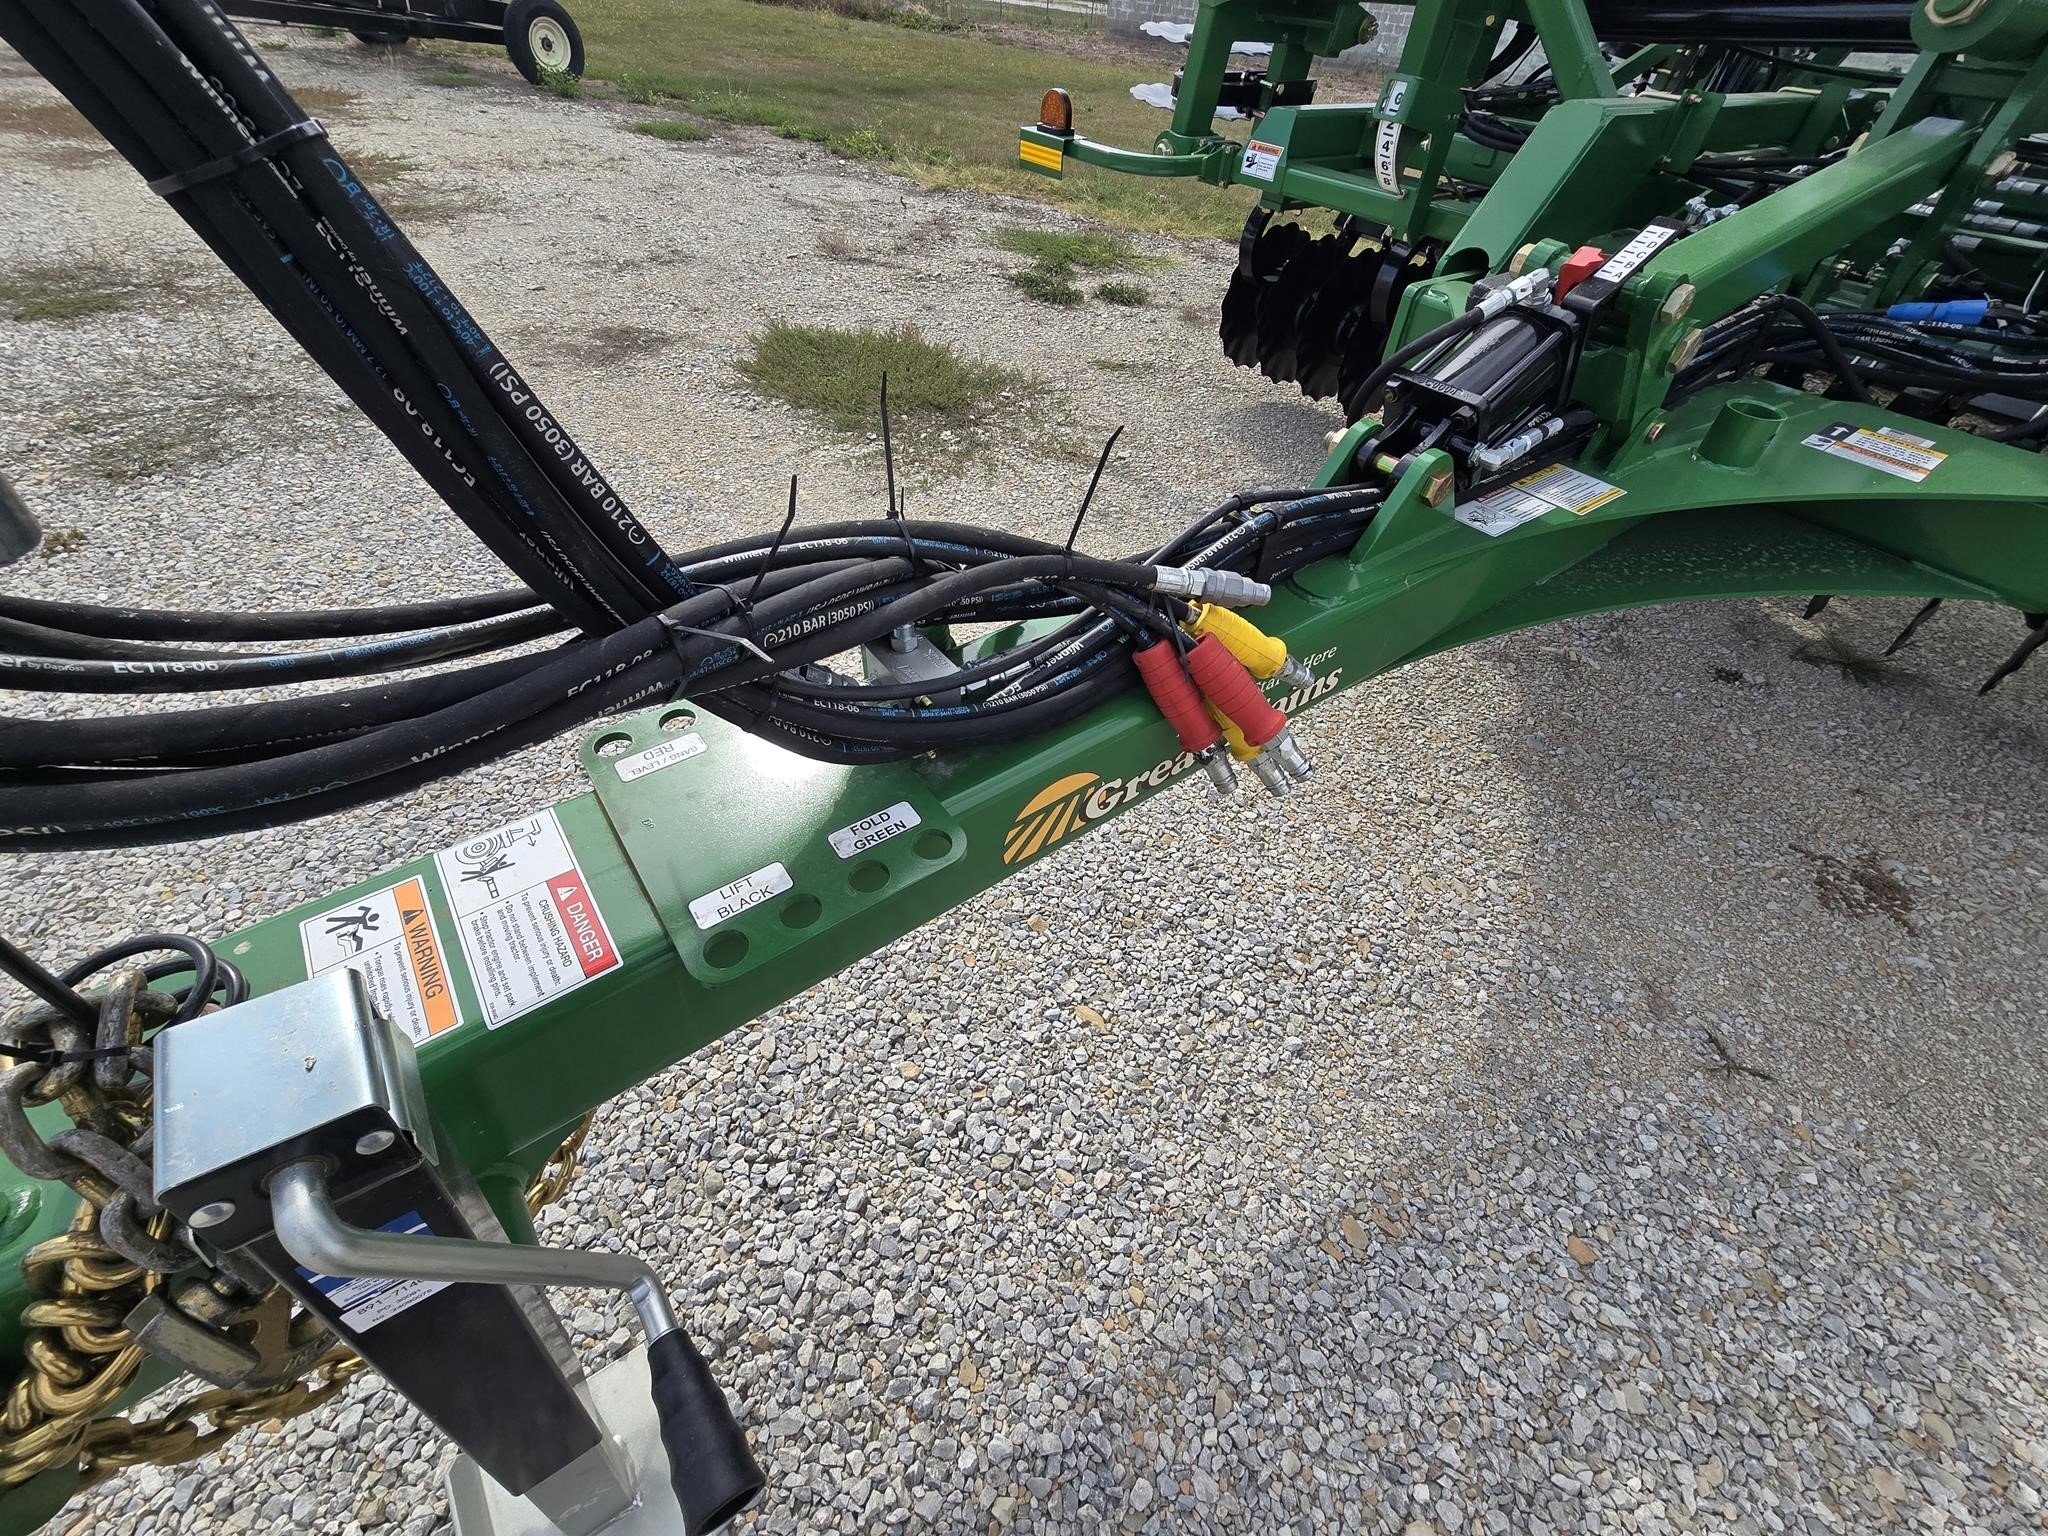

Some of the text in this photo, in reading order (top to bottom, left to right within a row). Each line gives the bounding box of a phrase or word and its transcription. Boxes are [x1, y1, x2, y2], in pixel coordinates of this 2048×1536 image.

[1646, 241, 1658, 249] D
[486, 359, 530, 406] PSI)
[522, 402, 577, 462] (3050
[568, 457, 607, 499] BAR
[600, 495, 634, 530] 210
[775, 597, 876, 643] 210 BAR (3050 PSI)
[27, 660, 219, 674] by Danfoss EC118-06
[1043, 639, 1084, 668] Winner
[1303, 645, 1337, 670] Here
[813, 698, 859, 713] EC118-06
[1266, 666, 1343, 718] ains
[642, 743, 674, 761] RED
[668, 745, 697, 761] GANG
[630, 759, 660, 776] LEVEL
[1082, 751, 1203, 821] Grea
[850, 812, 890, 836] FOLD
[854, 820, 906, 850] GREEN
[717, 885, 774, 919] BLACK
[720, 876, 754, 899] LIFT
[470, 919, 482, 936] brake
[496, 907, 521, 963] and moving tractor.
[520, 891, 562, 987] To prevent serious injury or death:
[537, 898, 572, 968] CRUSHING HAZARD
[565, 901, 605, 962] DANGER
[407, 921, 444, 1000] WARNING
[475, 935, 488, 956] before
[504, 903, 545, 998] Do not stand between implement
[371, 954, 386, 977] Tongue
[478, 914, 516, 1008] Stop tractor engine and set park
[480, 954, 498, 984] installing
[378, 976, 388, 991] rises
[391, 941, 423, 1038] To prevent serious injury or death:
[490, 981, 502, 999] pins.
[379, 990, 393, 1012] rapidly
